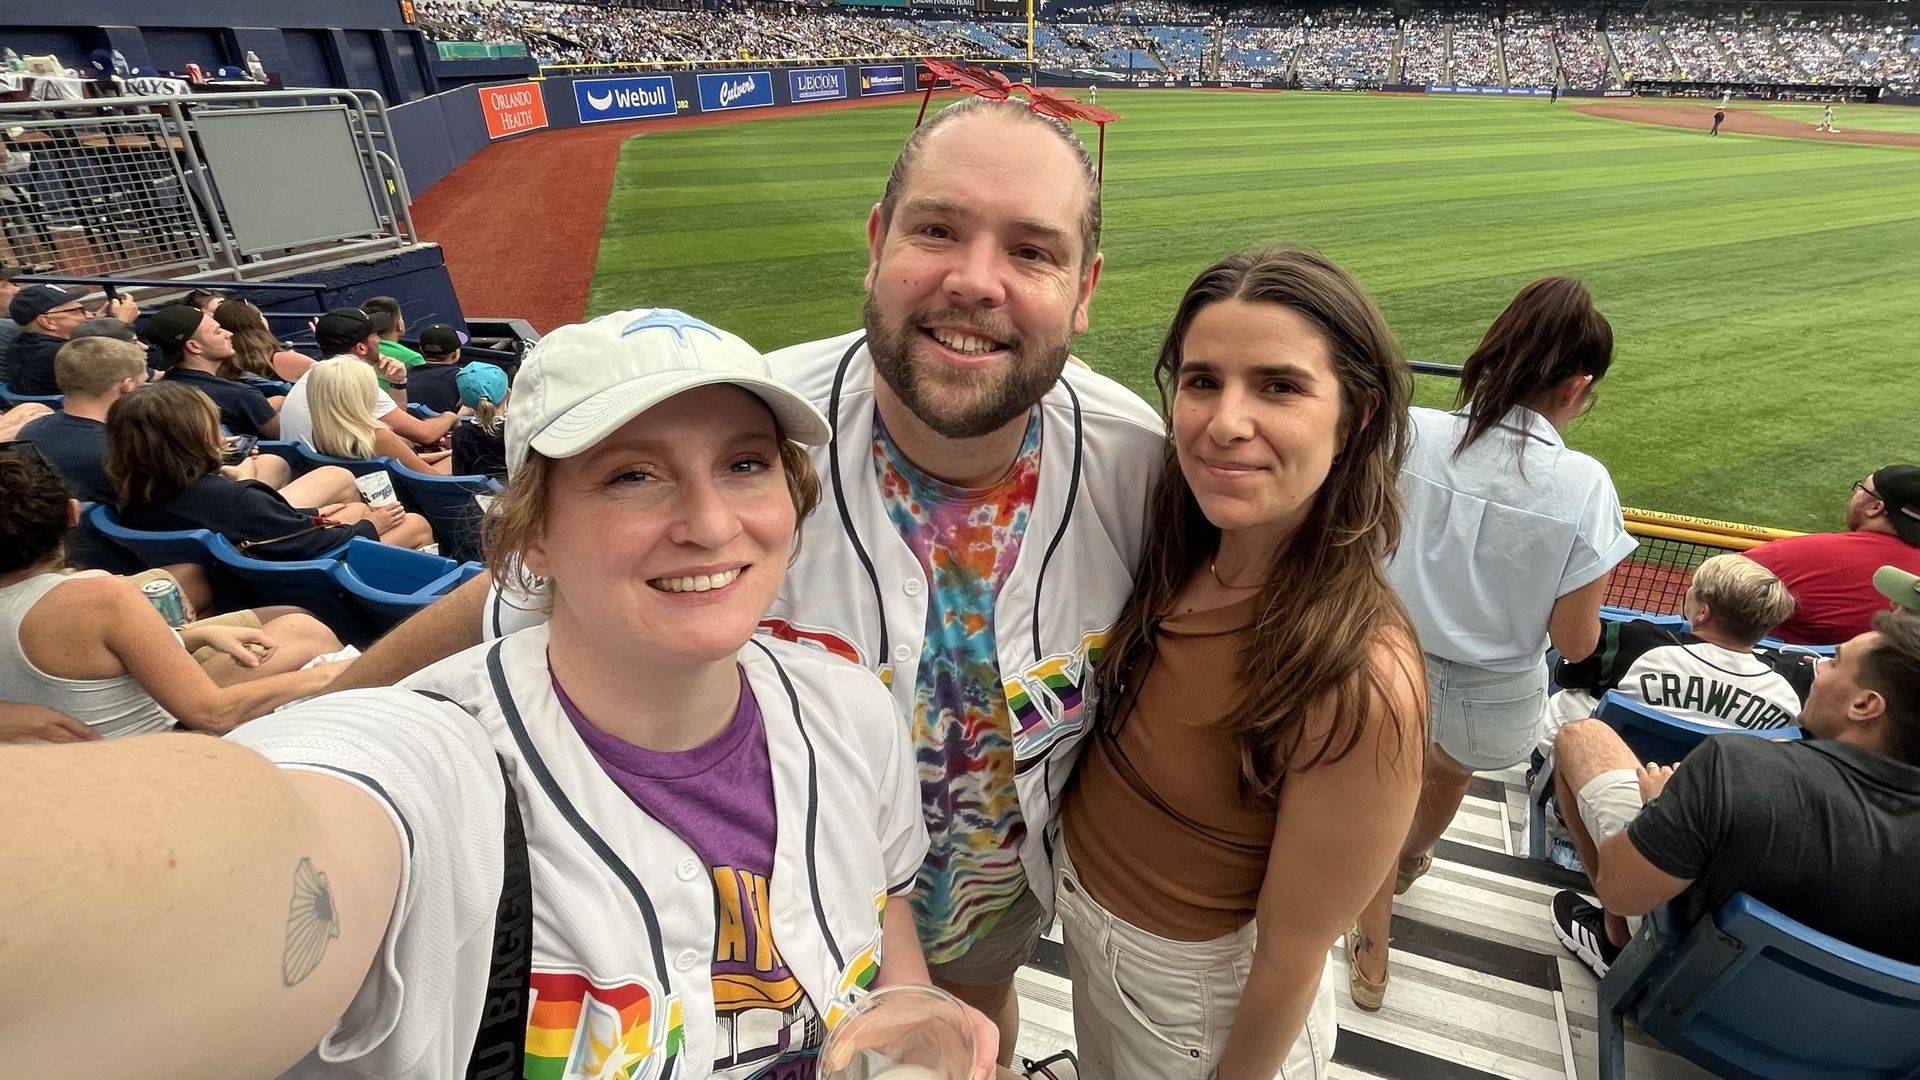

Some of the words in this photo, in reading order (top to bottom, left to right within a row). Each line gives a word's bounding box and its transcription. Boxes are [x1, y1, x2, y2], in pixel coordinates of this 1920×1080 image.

[719, 75, 756, 107] Culver's
[797, 74, 839, 91] LECOM
[490, 90, 533, 111] ORLANDO
[614, 86, 667, 109] Webull
[677, 100, 690, 109] 382
[500, 110, 534, 131] HEALTH
[1639, 673, 1791, 730] CRAWFORD
